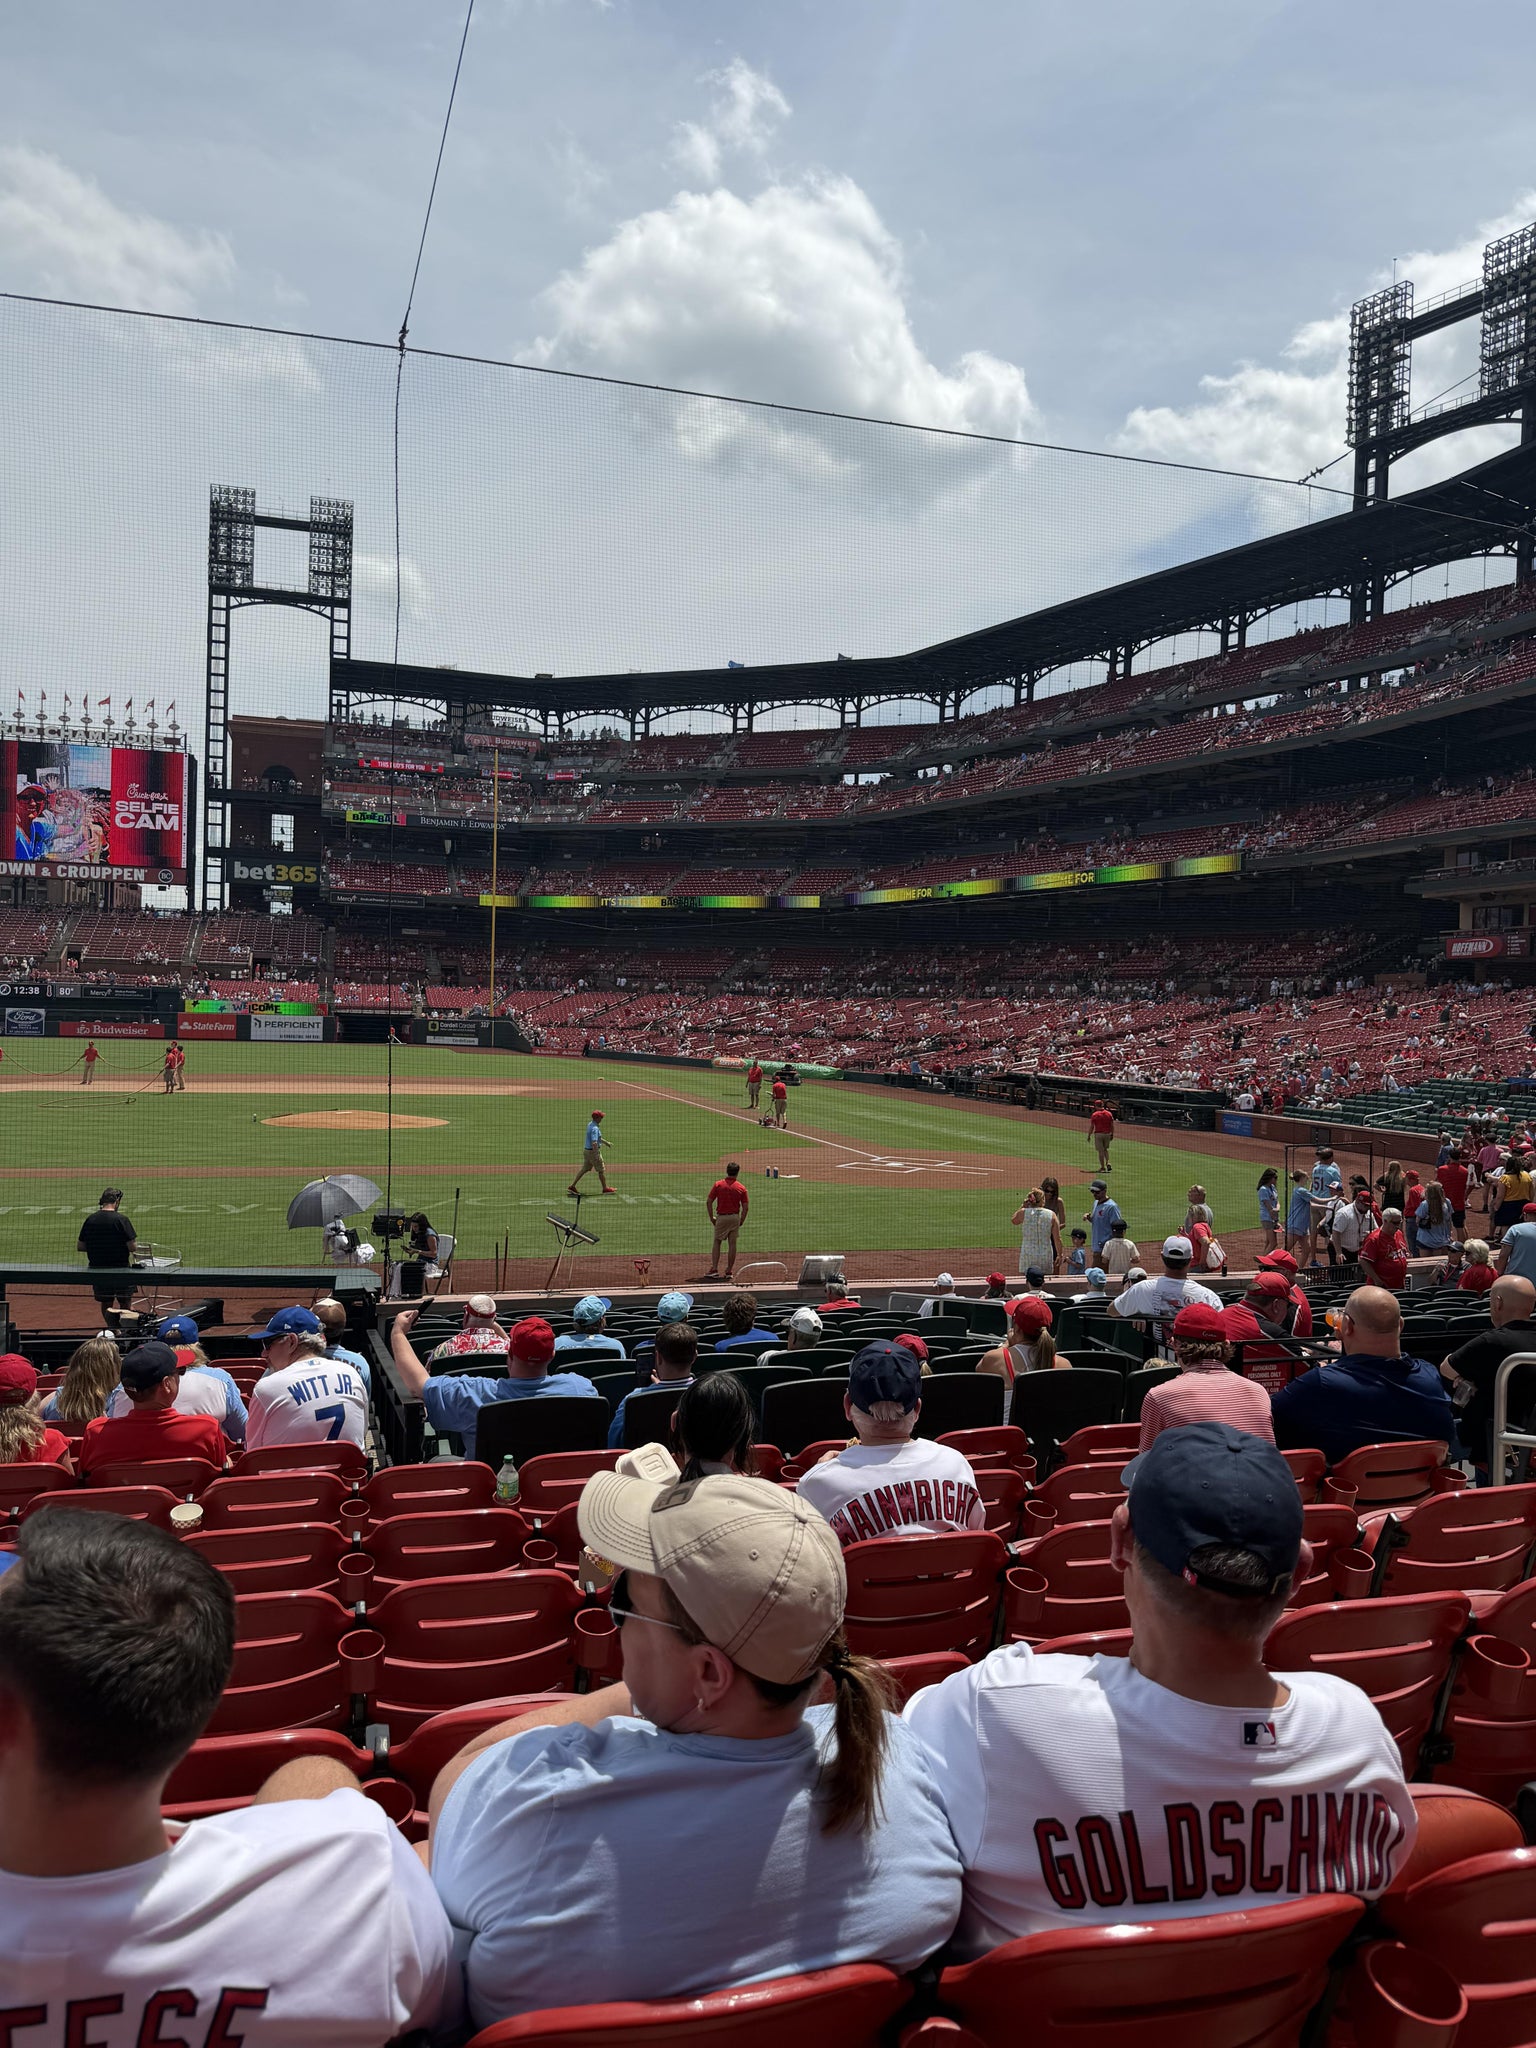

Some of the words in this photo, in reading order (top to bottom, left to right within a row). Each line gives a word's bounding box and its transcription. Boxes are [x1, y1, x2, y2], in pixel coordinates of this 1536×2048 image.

[44, 727, 165, 745] CHAMPIONS
[378, 759, 389, 767] THIS
[415, 763, 426, 771] YOU
[115, 800, 179, 815] SELFIE
[114, 812, 179, 831] CAM
[420, 816, 460, 828] BENJAMIN
[41, 867, 51, 876] &
[57, 865, 145, 881] CROUPPEN
[234, 861, 317, 883] bet365
[1075, 872, 1094, 885] FOR
[917, 888, 933, 898] FOR
[1451, 941, 1488, 953] HOFFMANN
[14, 986, 40, 995] 12:38
[13, 1010, 37, 1021] Ford
[93, 1024, 149, 1035] Budweiser
[264, 1020, 321, 1029] PERFICIENT
[1313, 1176, 1324, 1191] 51
[287, 1374, 330, 1407] WITT
[334, 1374, 356, 1397] JR.
[315, 1403, 346, 1441] 7
[829, 1478, 981, 1547] WAINWRIGHT
